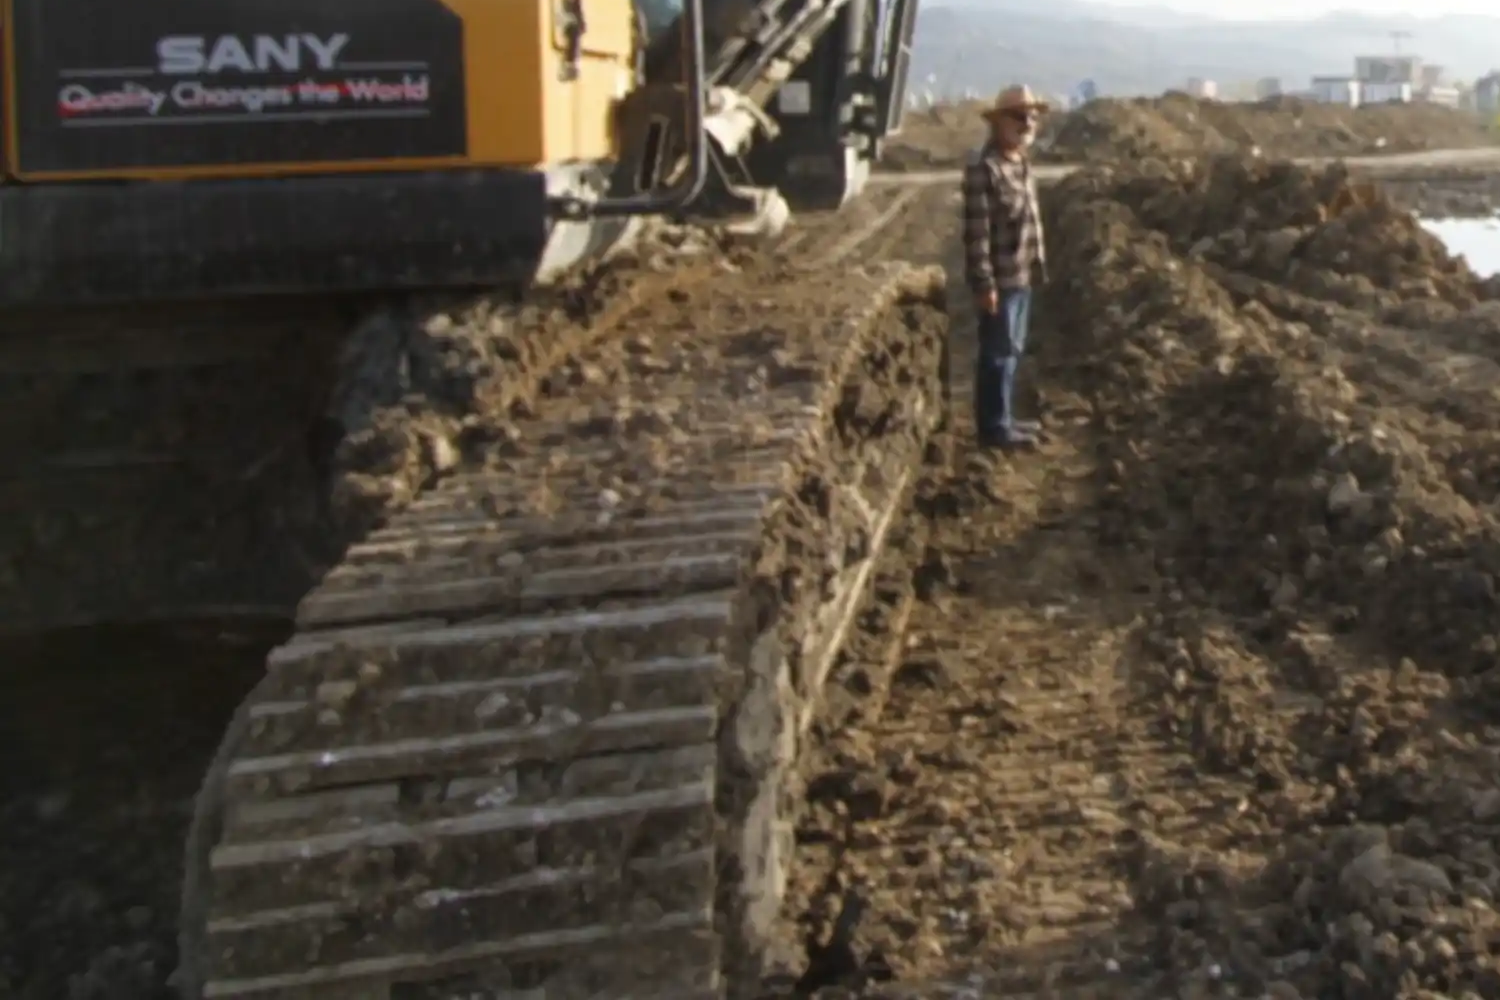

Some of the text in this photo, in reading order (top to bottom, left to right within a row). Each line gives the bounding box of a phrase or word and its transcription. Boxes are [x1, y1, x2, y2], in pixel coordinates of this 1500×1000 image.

[157, 33, 348, 73] SANY
[59, 74, 430, 115] Quality Changes the World
